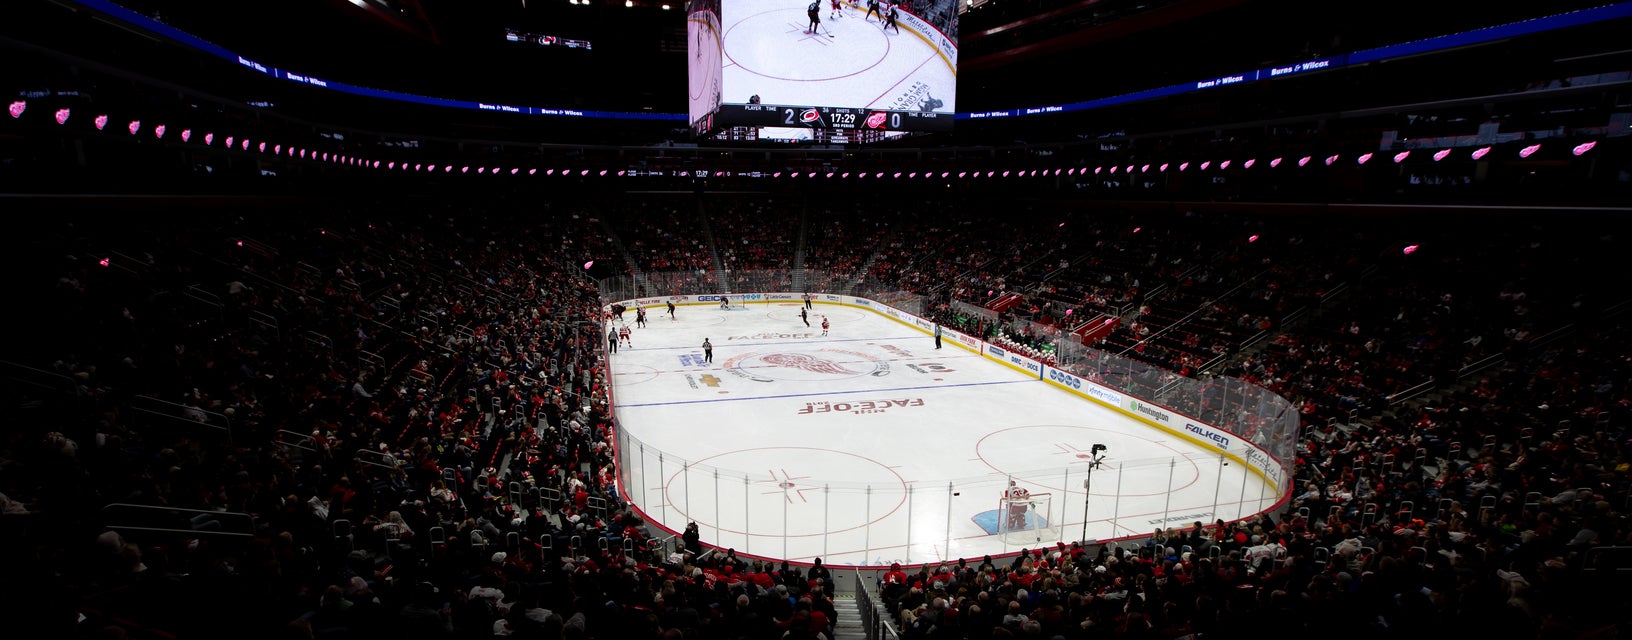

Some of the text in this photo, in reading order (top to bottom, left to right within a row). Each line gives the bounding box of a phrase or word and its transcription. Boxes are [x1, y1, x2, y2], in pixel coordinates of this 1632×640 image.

[1271, 66, 1292, 76] Burns
[1302, 60, 1329, 70] Wilcox
[1222, 76, 1243, 84] Wilcox
[784, 109, 794, 124] 2
[830, 113, 856, 124] 17:29
[891, 113, 901, 128] 0
[1011, 356, 1022, 365] DMC
[1026, 362, 1038, 372] DOCS
[798, 398, 925, 414] FACE-OFF
[1137, 402, 1169, 422] Huntington
[1185, 424, 1229, 446] FALKEN
